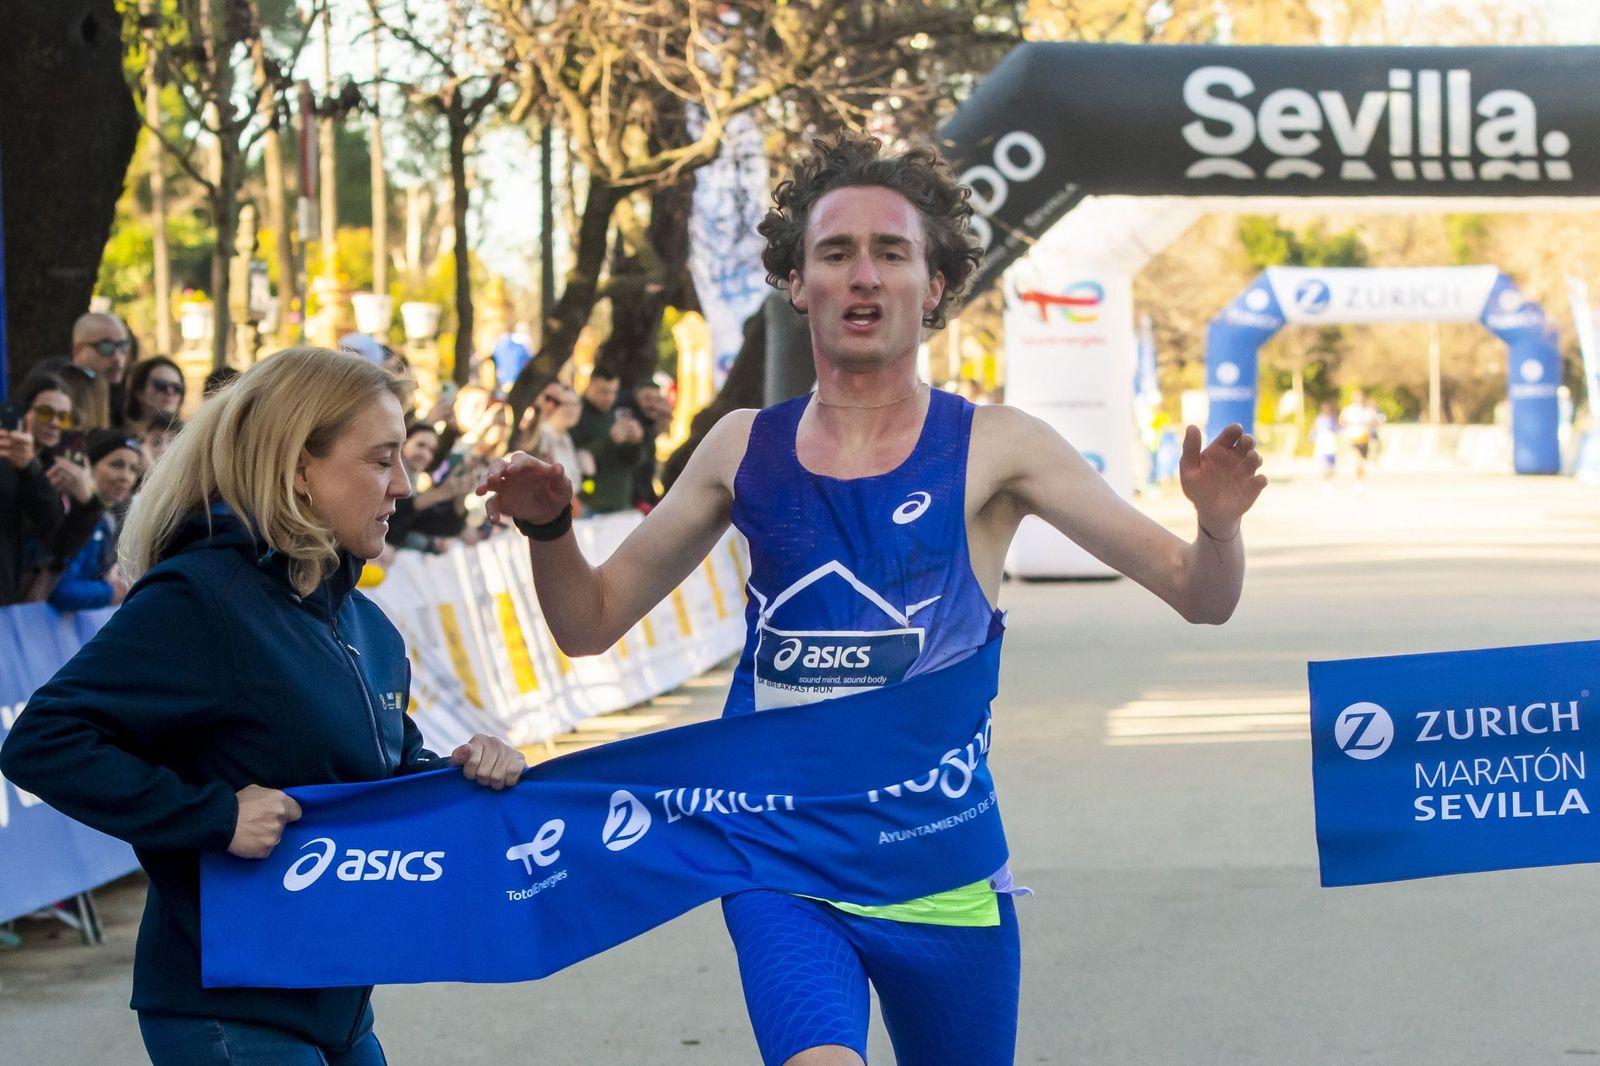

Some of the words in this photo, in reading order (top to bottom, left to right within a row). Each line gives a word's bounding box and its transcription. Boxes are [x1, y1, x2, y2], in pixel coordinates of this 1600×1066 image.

[1181, 65, 1571, 158] Sevilla.
[1344, 286, 1462, 310] ZURICH
[802, 645, 872, 669] asics
[766, 680, 810, 693] BREAKFAST
[813, 686, 834, 694] RUN
[798, 675, 821, 684] sound
[843, 675, 865, 684] sound
[867, 675, 888, 685] body
[1415, 700, 1581, 742] ZURICH
[1414, 746, 1586, 789] MARATÓN
[1413, 788, 1591, 822] SEVILLA
[336, 849, 446, 882] asics
[506, 869, 568, 901] TotalEnergies
